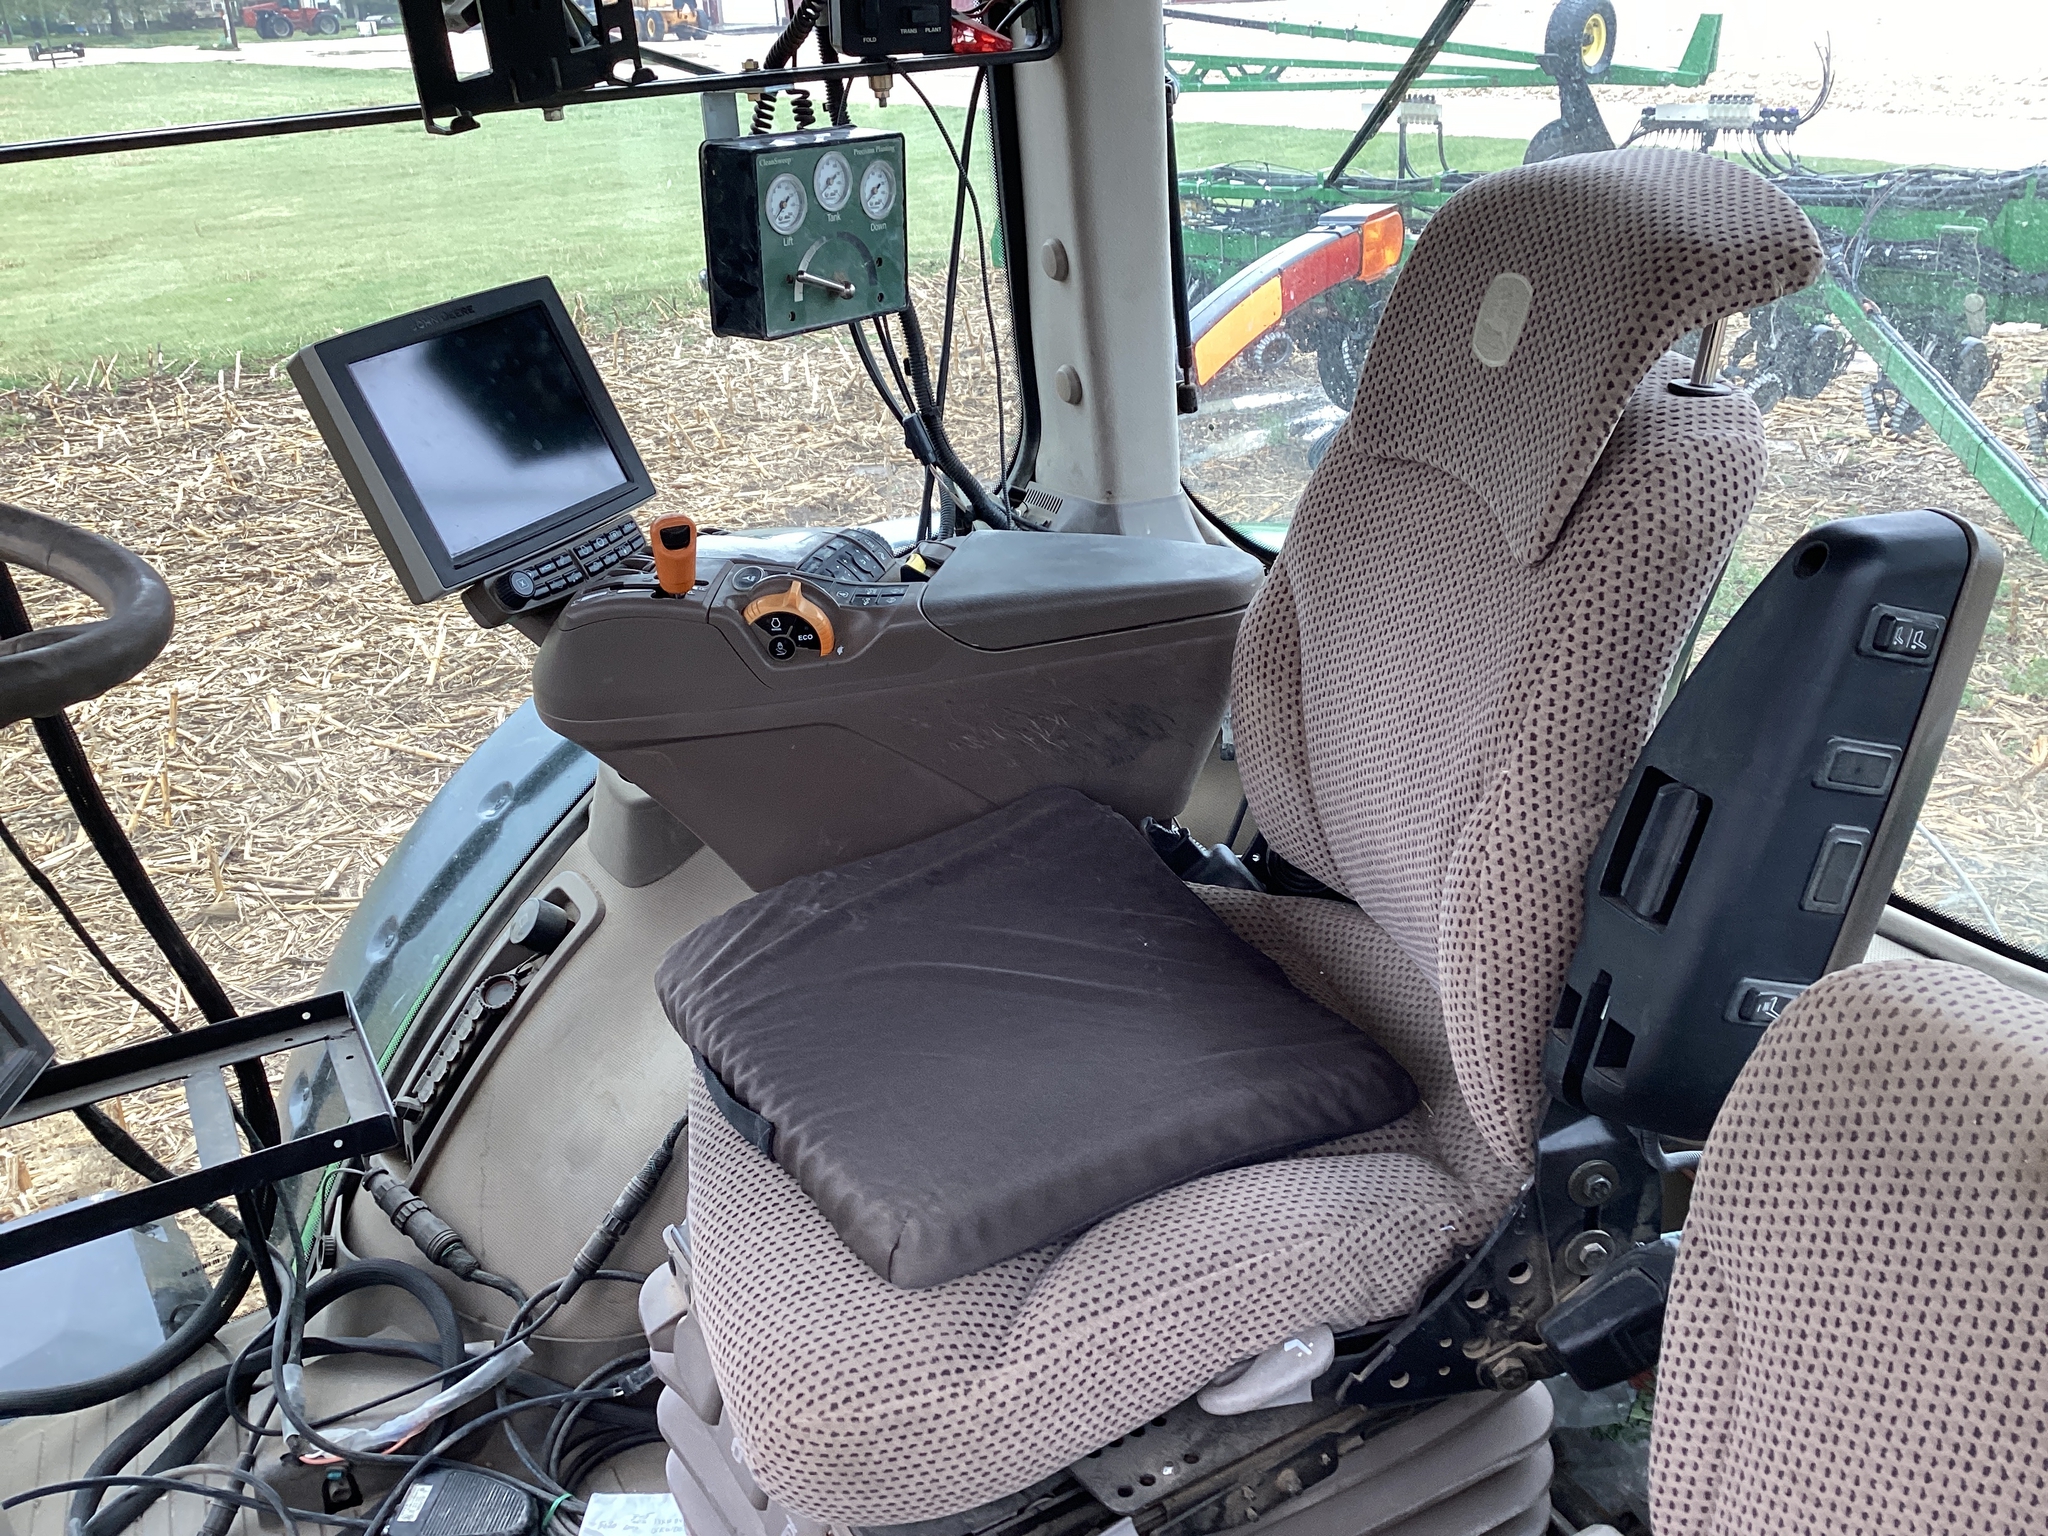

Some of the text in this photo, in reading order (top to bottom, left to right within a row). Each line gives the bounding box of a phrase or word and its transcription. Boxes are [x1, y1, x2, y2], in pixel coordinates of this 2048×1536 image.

[759, 157, 792, 167] CleanSweep
[827, 212, 841, 222] Tank
[870, 222, 887, 232] Down
[783, 236, 794, 247] Lift
[441, 305, 475, 321] DEERE
